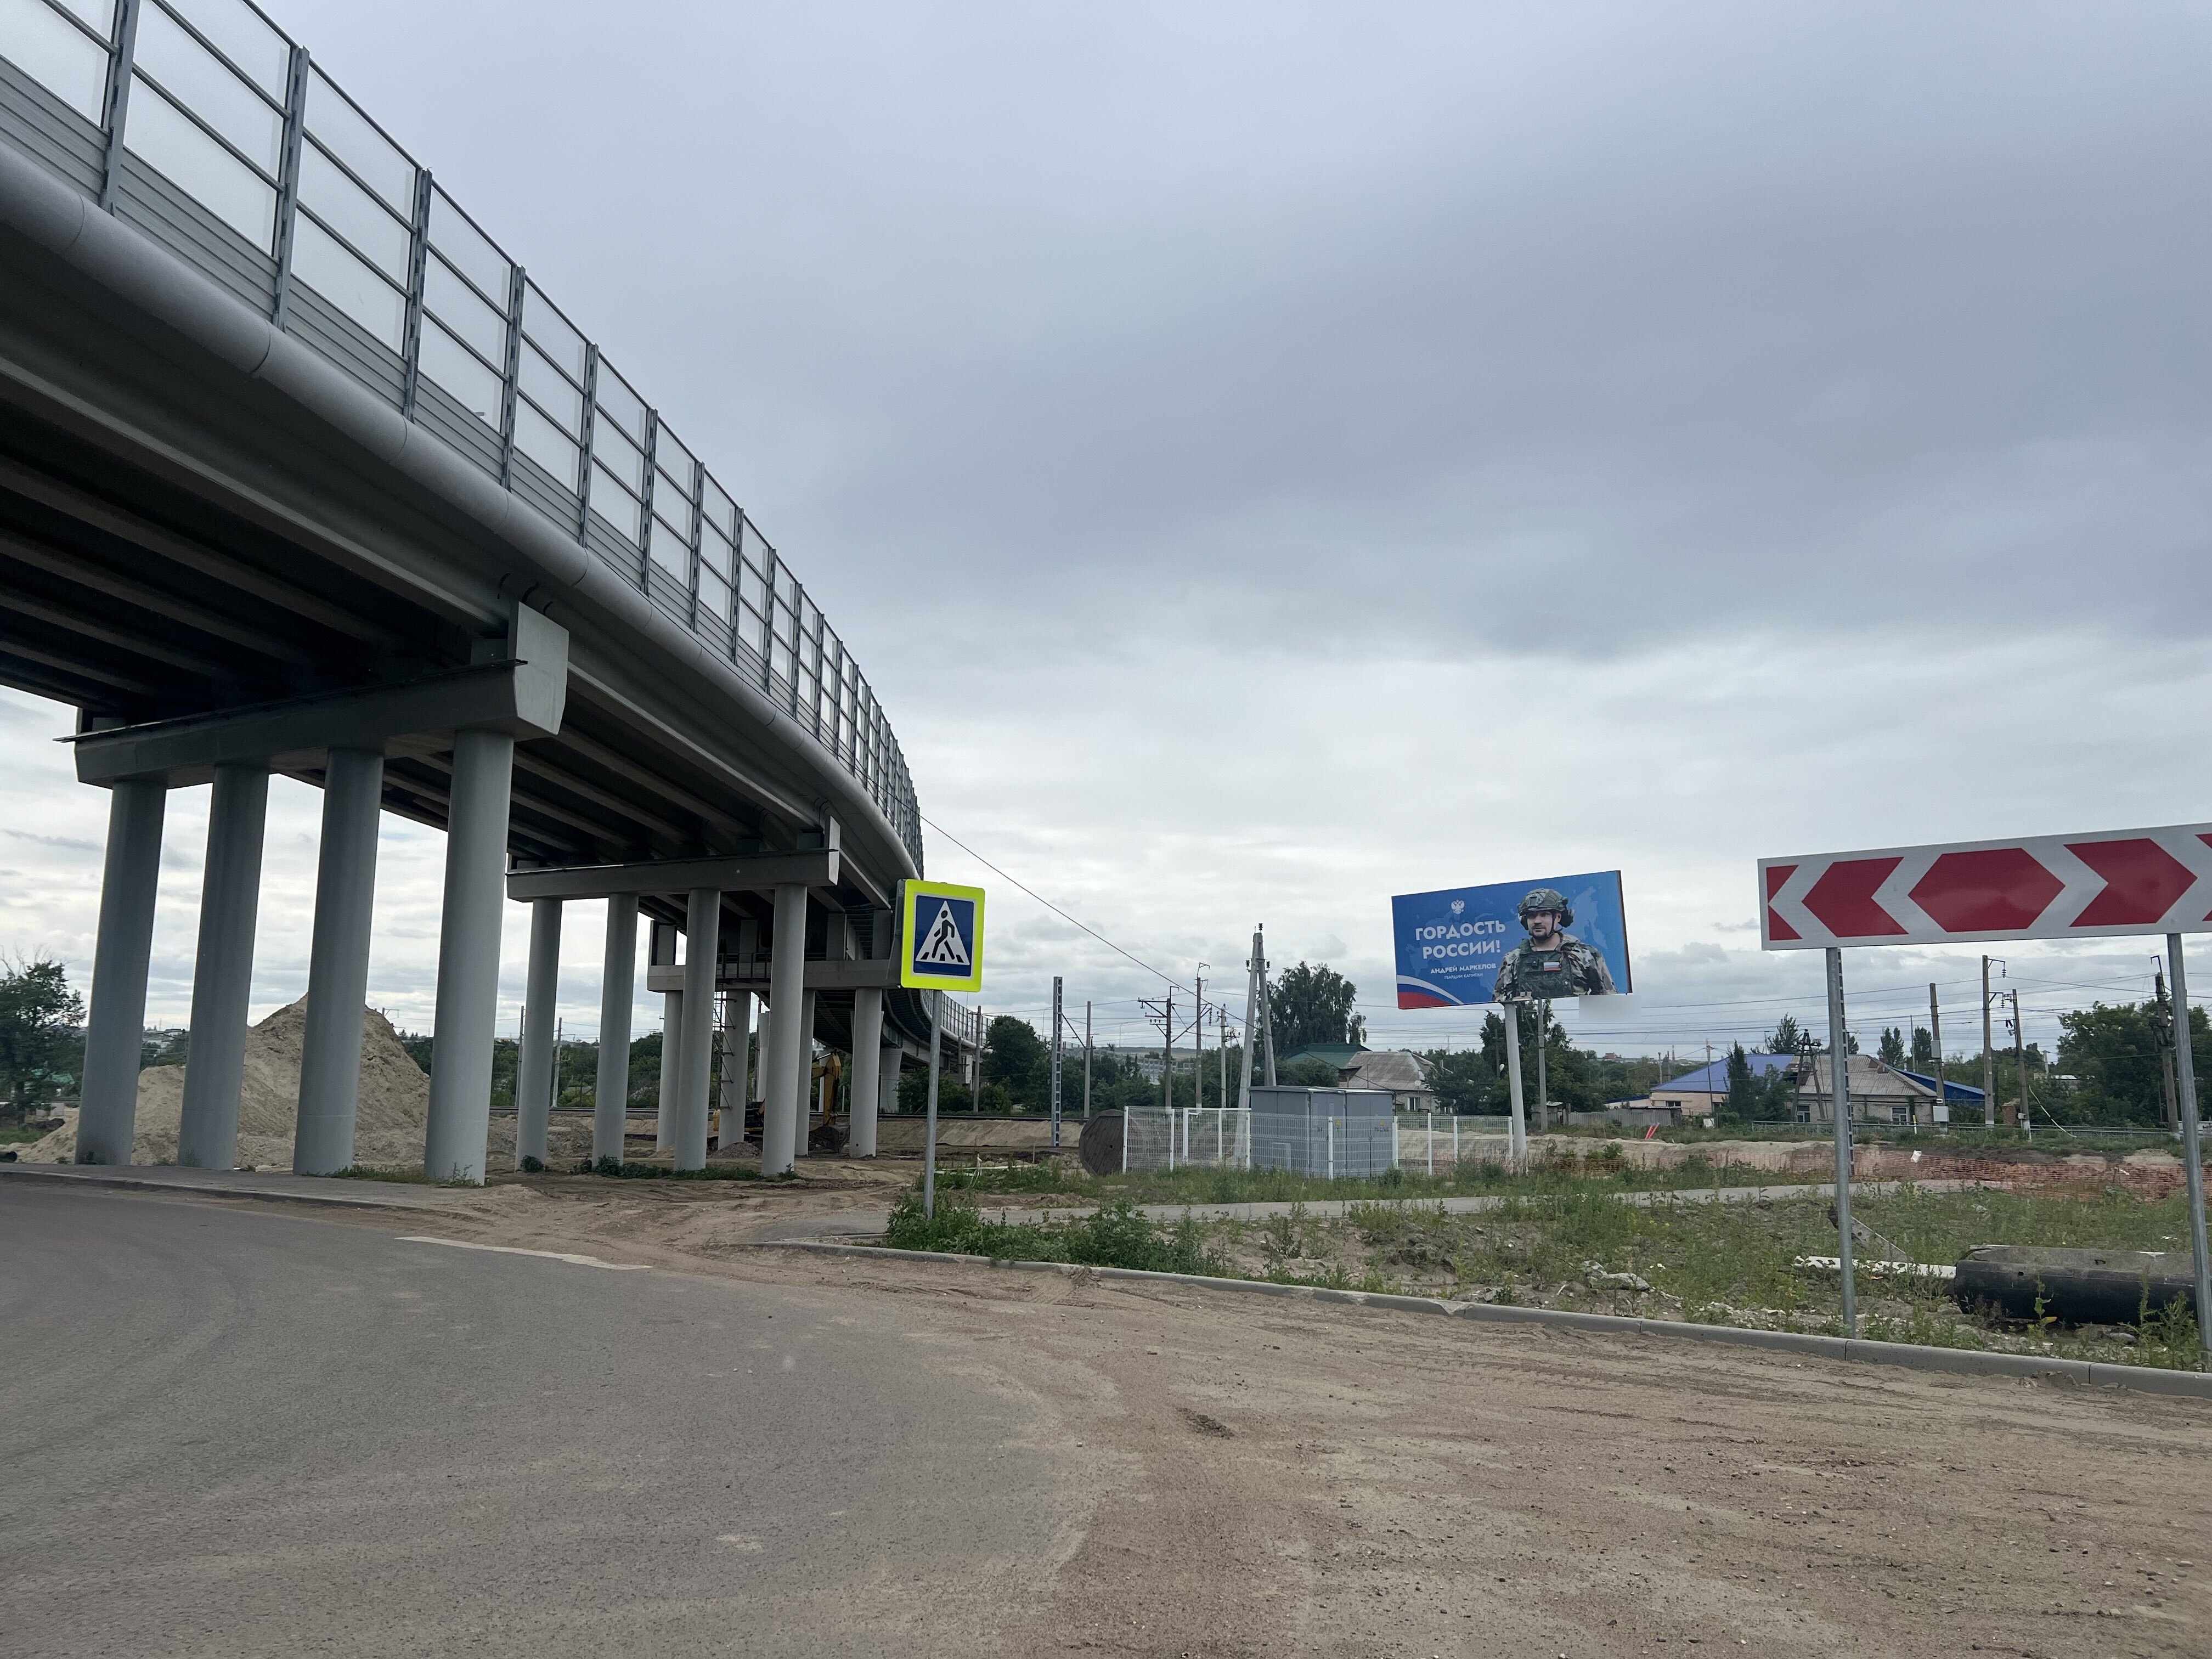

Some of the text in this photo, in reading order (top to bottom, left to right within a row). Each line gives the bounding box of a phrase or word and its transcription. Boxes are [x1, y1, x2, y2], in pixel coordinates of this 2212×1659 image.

[1415, 920, 1506, 941] ГОРДОСТЬ
[1422, 940, 1501, 959] РОССИИ!
[1430, 963, 1497, 974] АНДРЕЙ МАРКЕЛОВ
